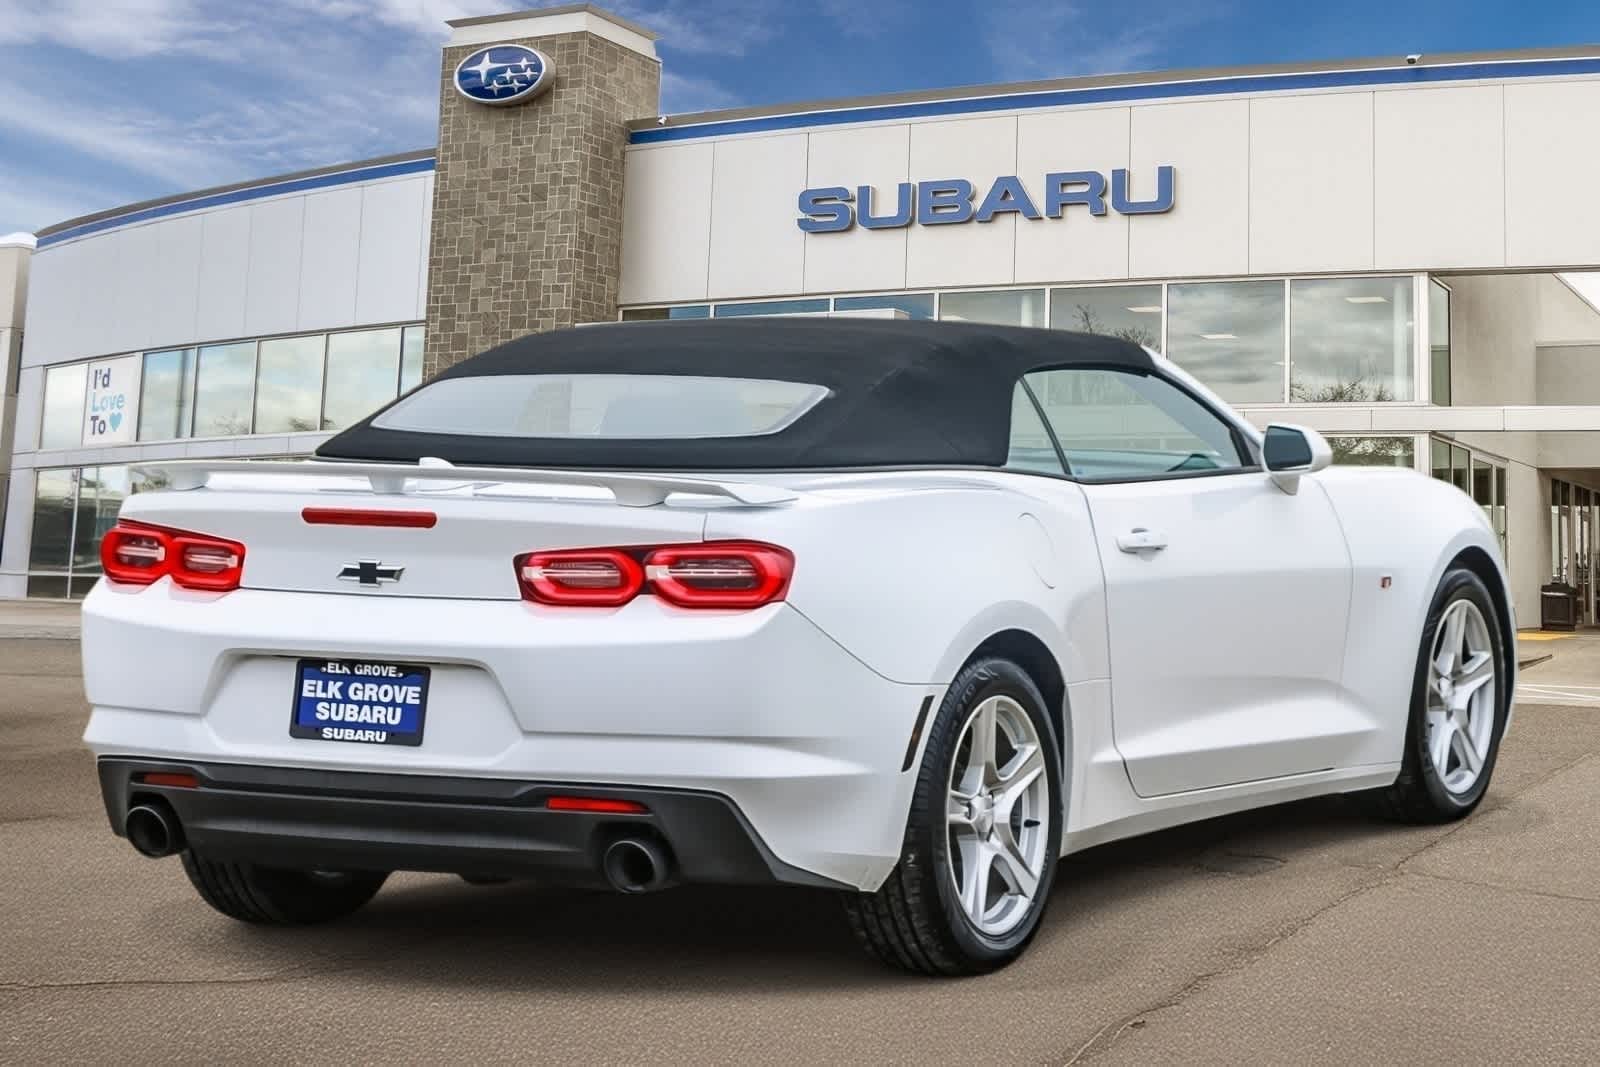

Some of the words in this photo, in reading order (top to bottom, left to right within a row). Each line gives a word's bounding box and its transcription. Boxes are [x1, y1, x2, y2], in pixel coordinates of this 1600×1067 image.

[796, 165, 1176, 234] SUBARU
[93, 367, 111, 390] I'd
[91, 391, 125, 412] Love
[90, 415, 106, 435] To
[354, 663, 397, 678] GROVE
[301, 679, 344, 700] ELK
[348, 682, 421, 705] GROVE
[315, 701, 402, 725] SUBARU
[321, 727, 387, 742] SUBARU
